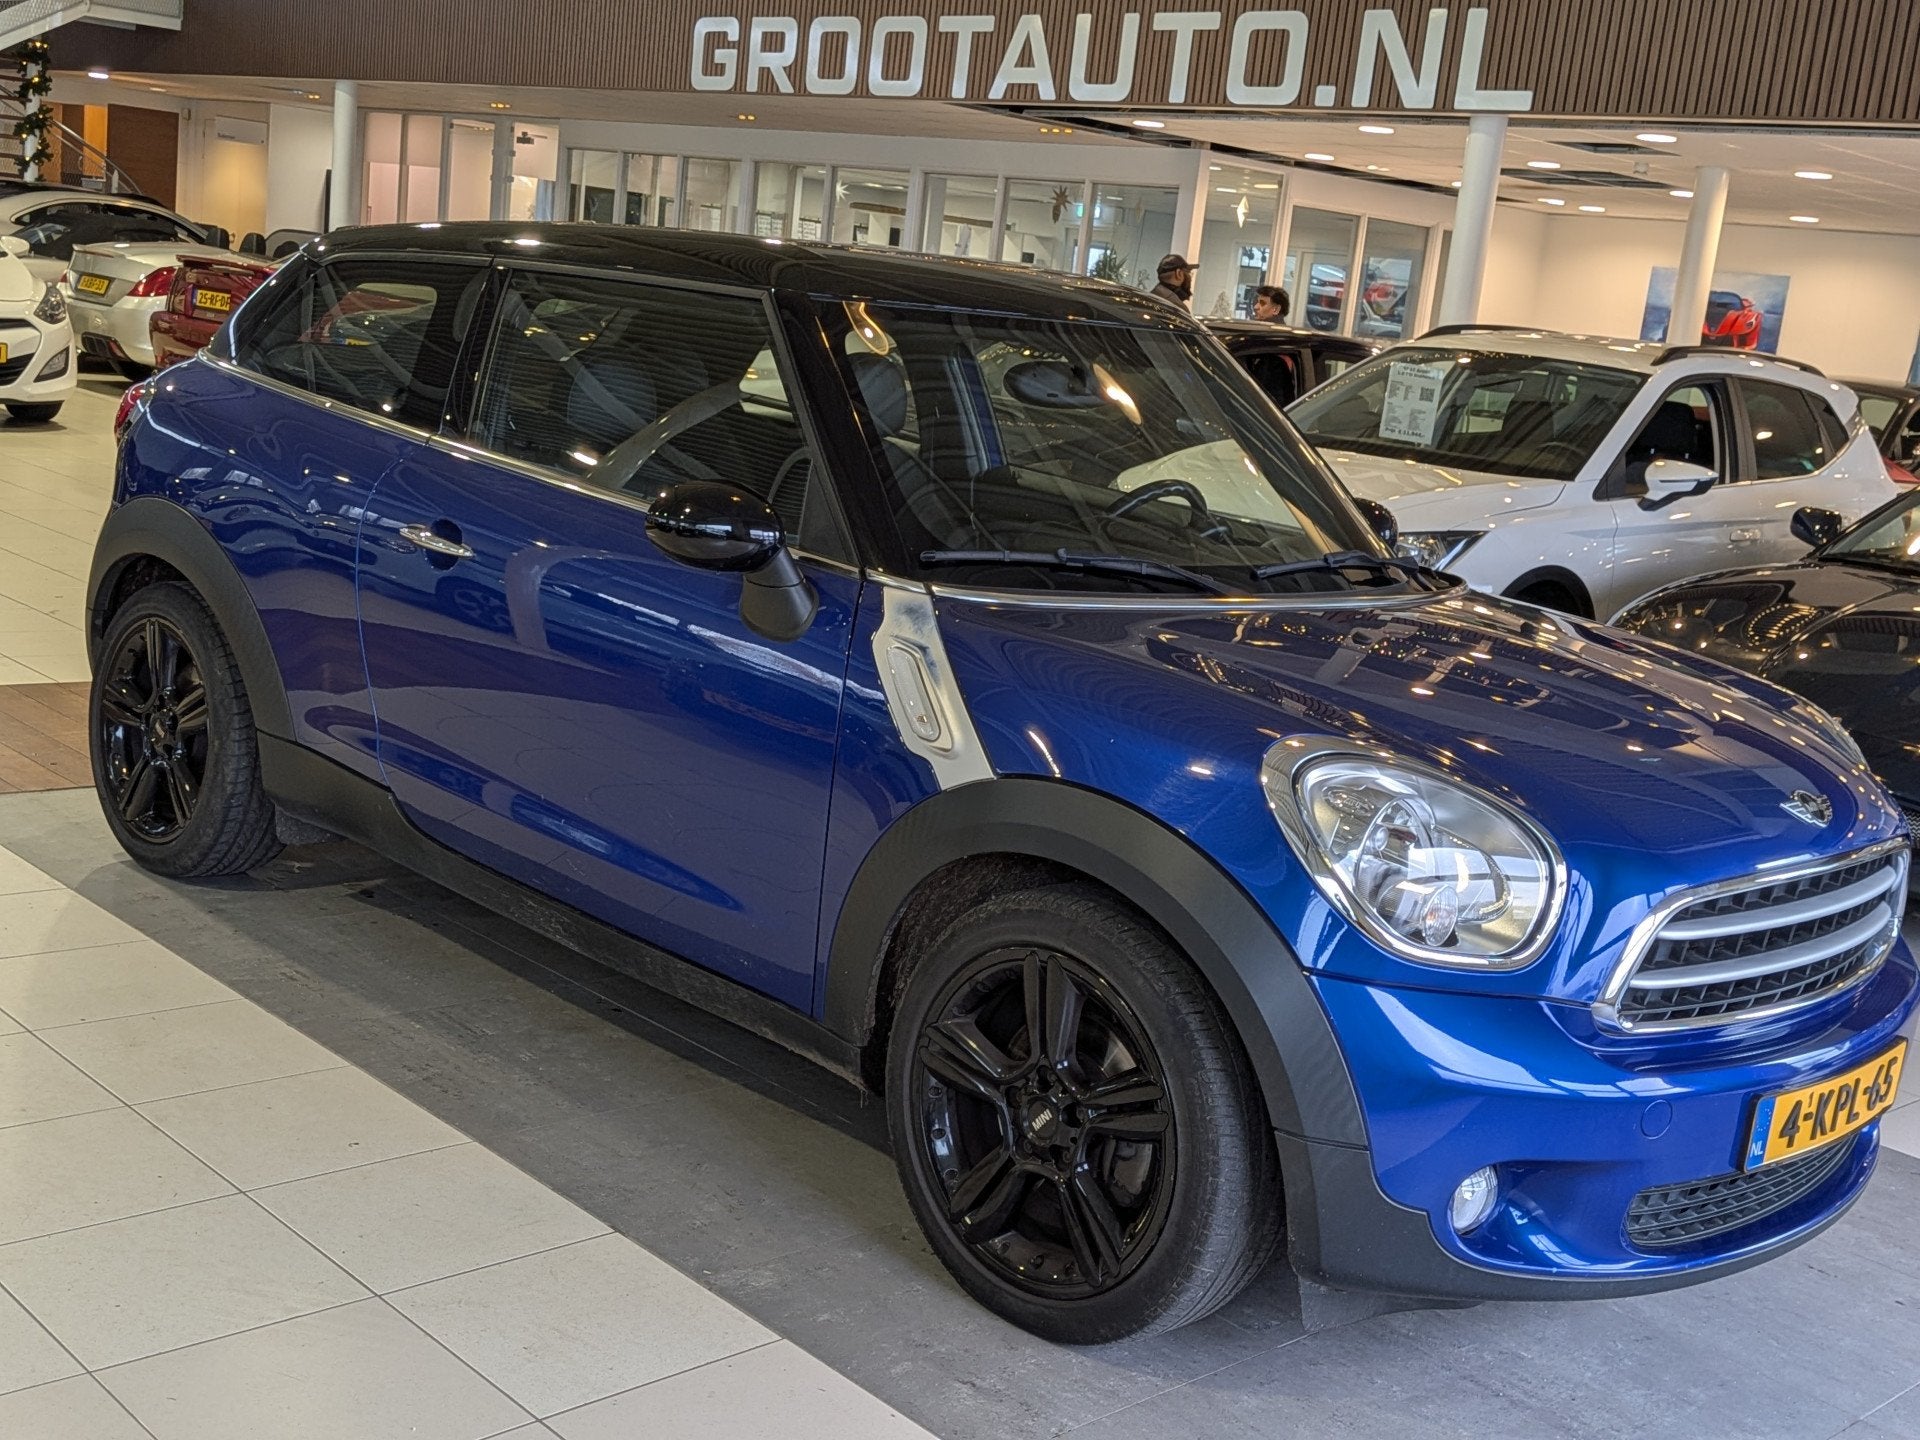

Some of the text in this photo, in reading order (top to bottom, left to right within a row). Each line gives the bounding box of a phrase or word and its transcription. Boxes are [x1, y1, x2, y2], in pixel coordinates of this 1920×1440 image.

[690, 7, 1534, 111] GROOTAUTO.NL
[1031, 1108, 1053, 1131] MINI
[1778, 1056, 1899, 1149] 4-KPL-65
[1749, 1140, 1764, 1158] NL
